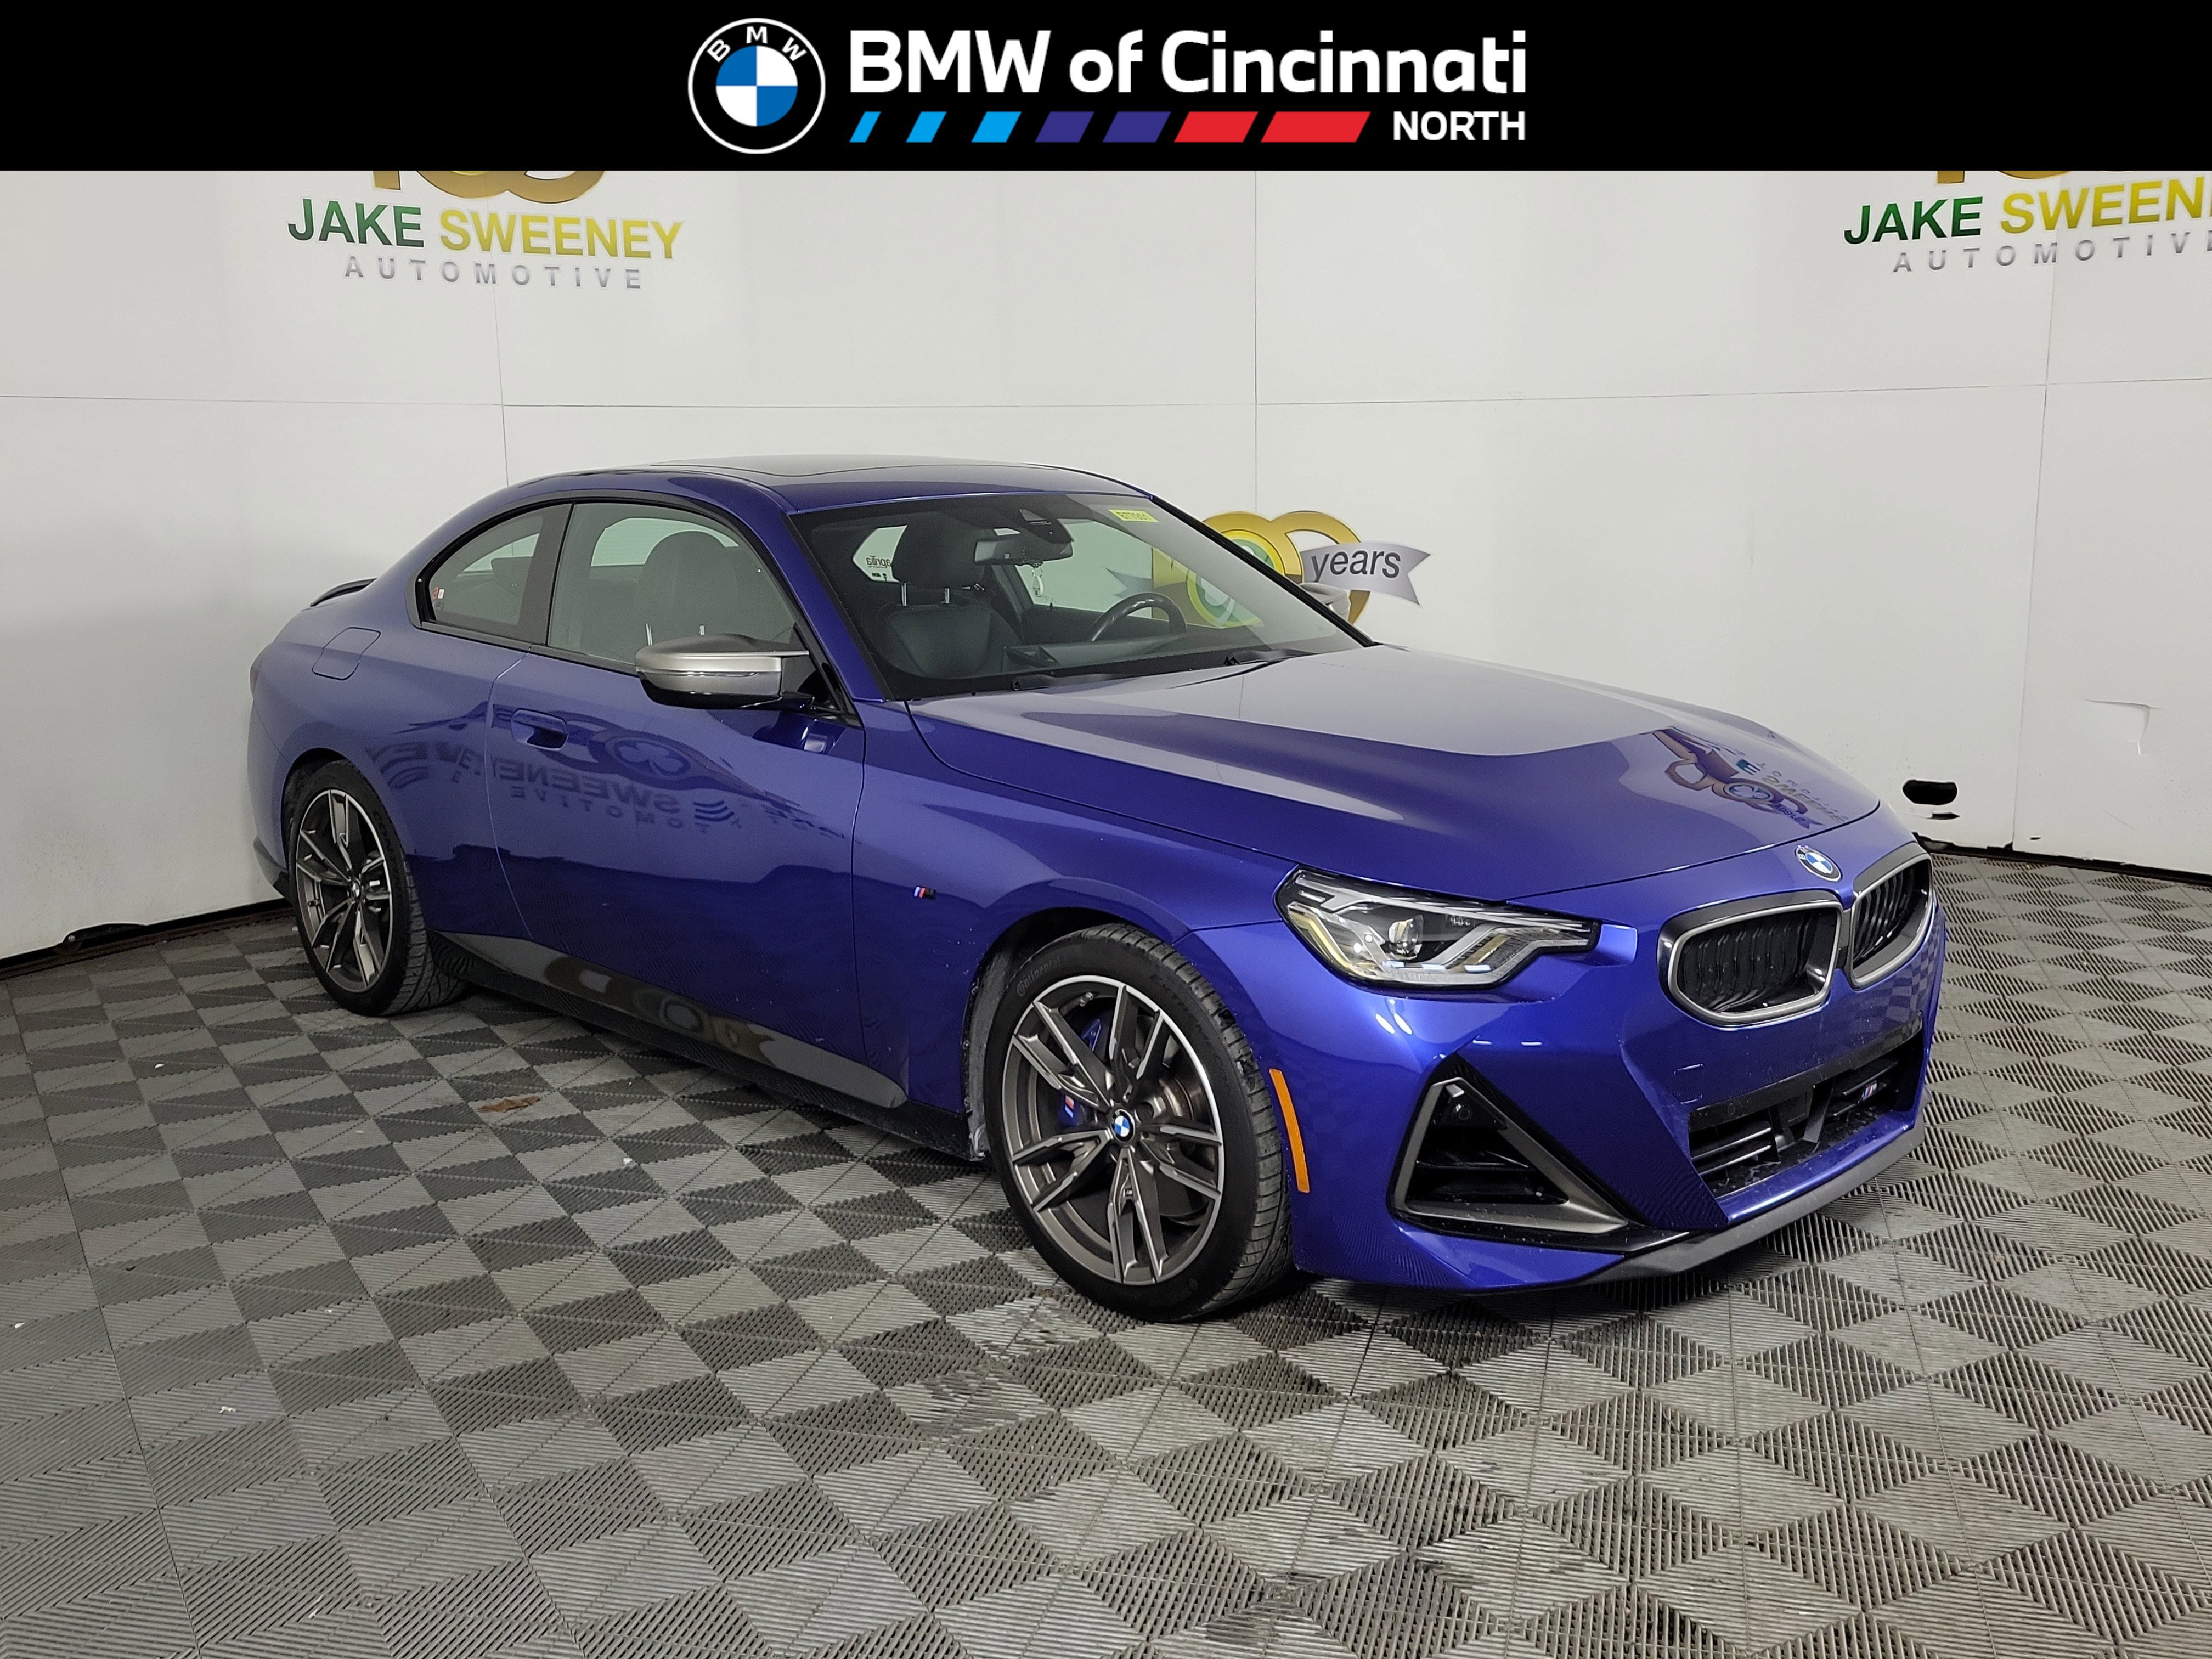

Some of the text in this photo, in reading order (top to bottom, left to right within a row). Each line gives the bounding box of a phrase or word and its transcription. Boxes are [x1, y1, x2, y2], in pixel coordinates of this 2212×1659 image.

[287, 199, 684, 259] JAKE SWEENEY
[1844, 196, 1983, 245] JAKE
[345, 256, 641, 290] AUTOMOTIVE
[1893, 229, 2212, 273] AUTOMOTIV
[1312, 549, 1402, 582] years
